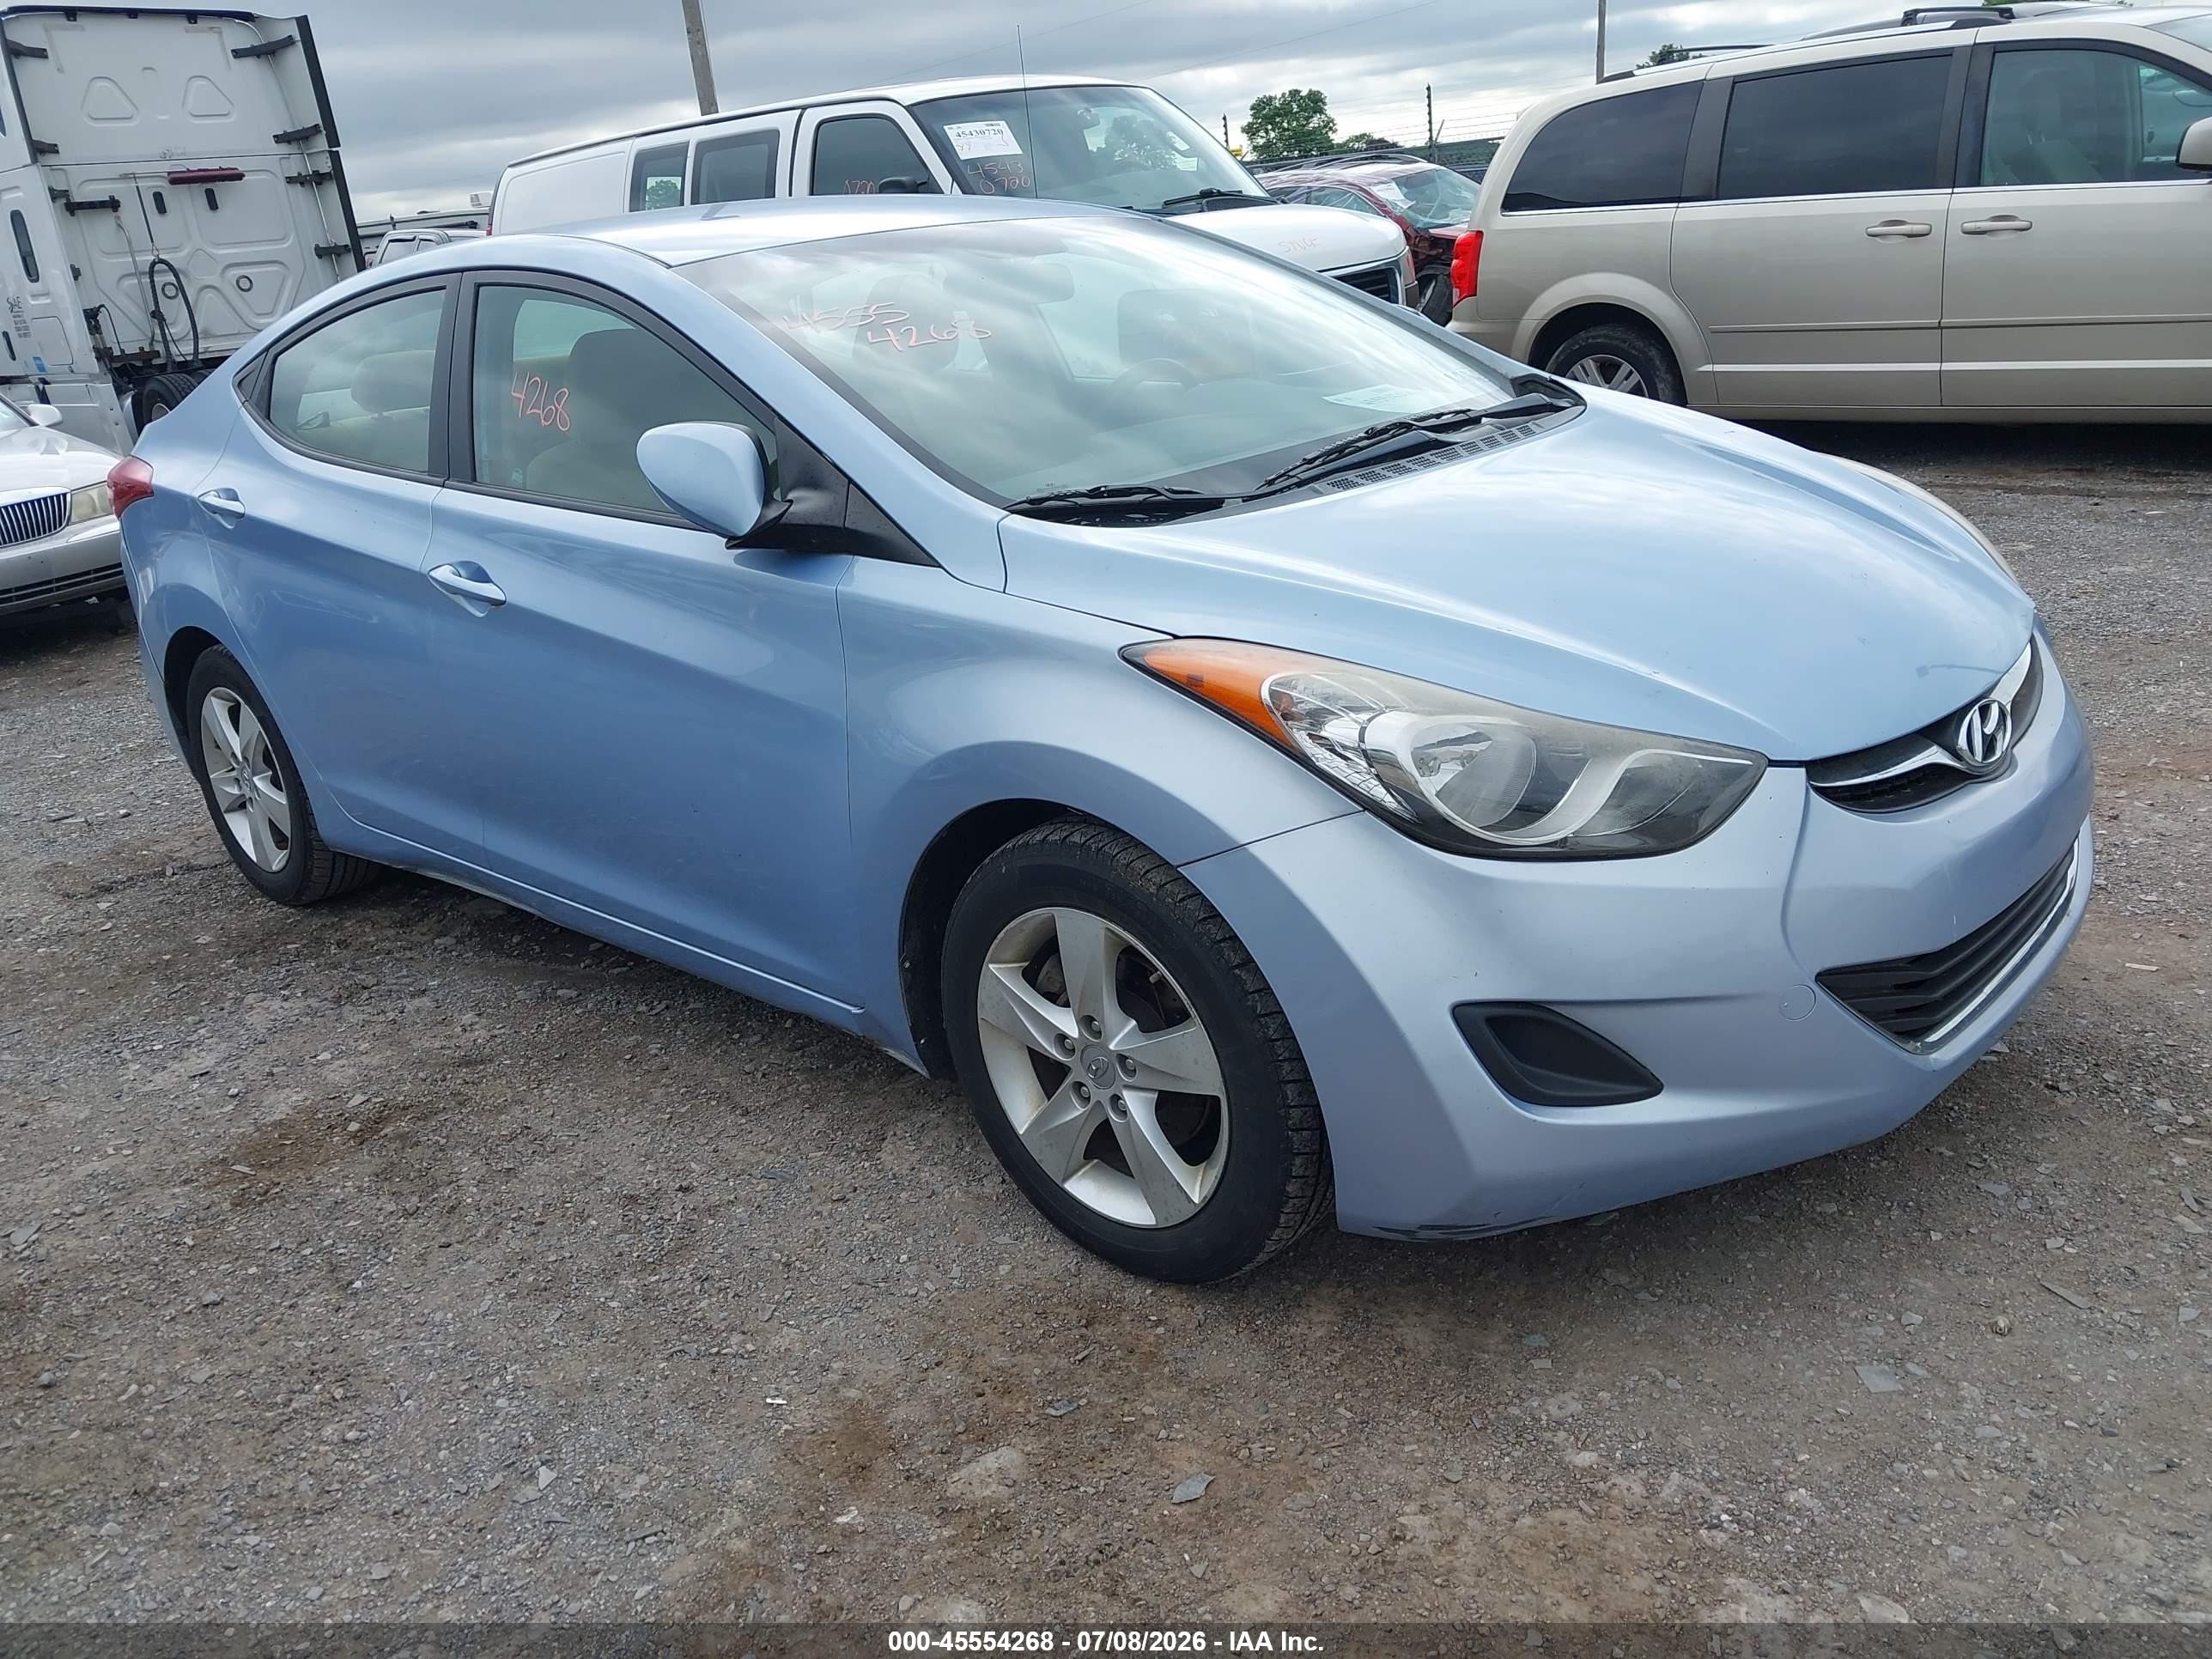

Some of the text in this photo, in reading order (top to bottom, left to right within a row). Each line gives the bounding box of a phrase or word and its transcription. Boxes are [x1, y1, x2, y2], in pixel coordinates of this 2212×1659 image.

[955, 127, 1004, 139] 45430720
[967, 161, 1024, 179] 4543
[980, 175, 1030, 194] 0720
[782, 301, 911, 334] 4555
[866, 318, 993, 352] 4268
[511, 371, 571, 431] 4268
